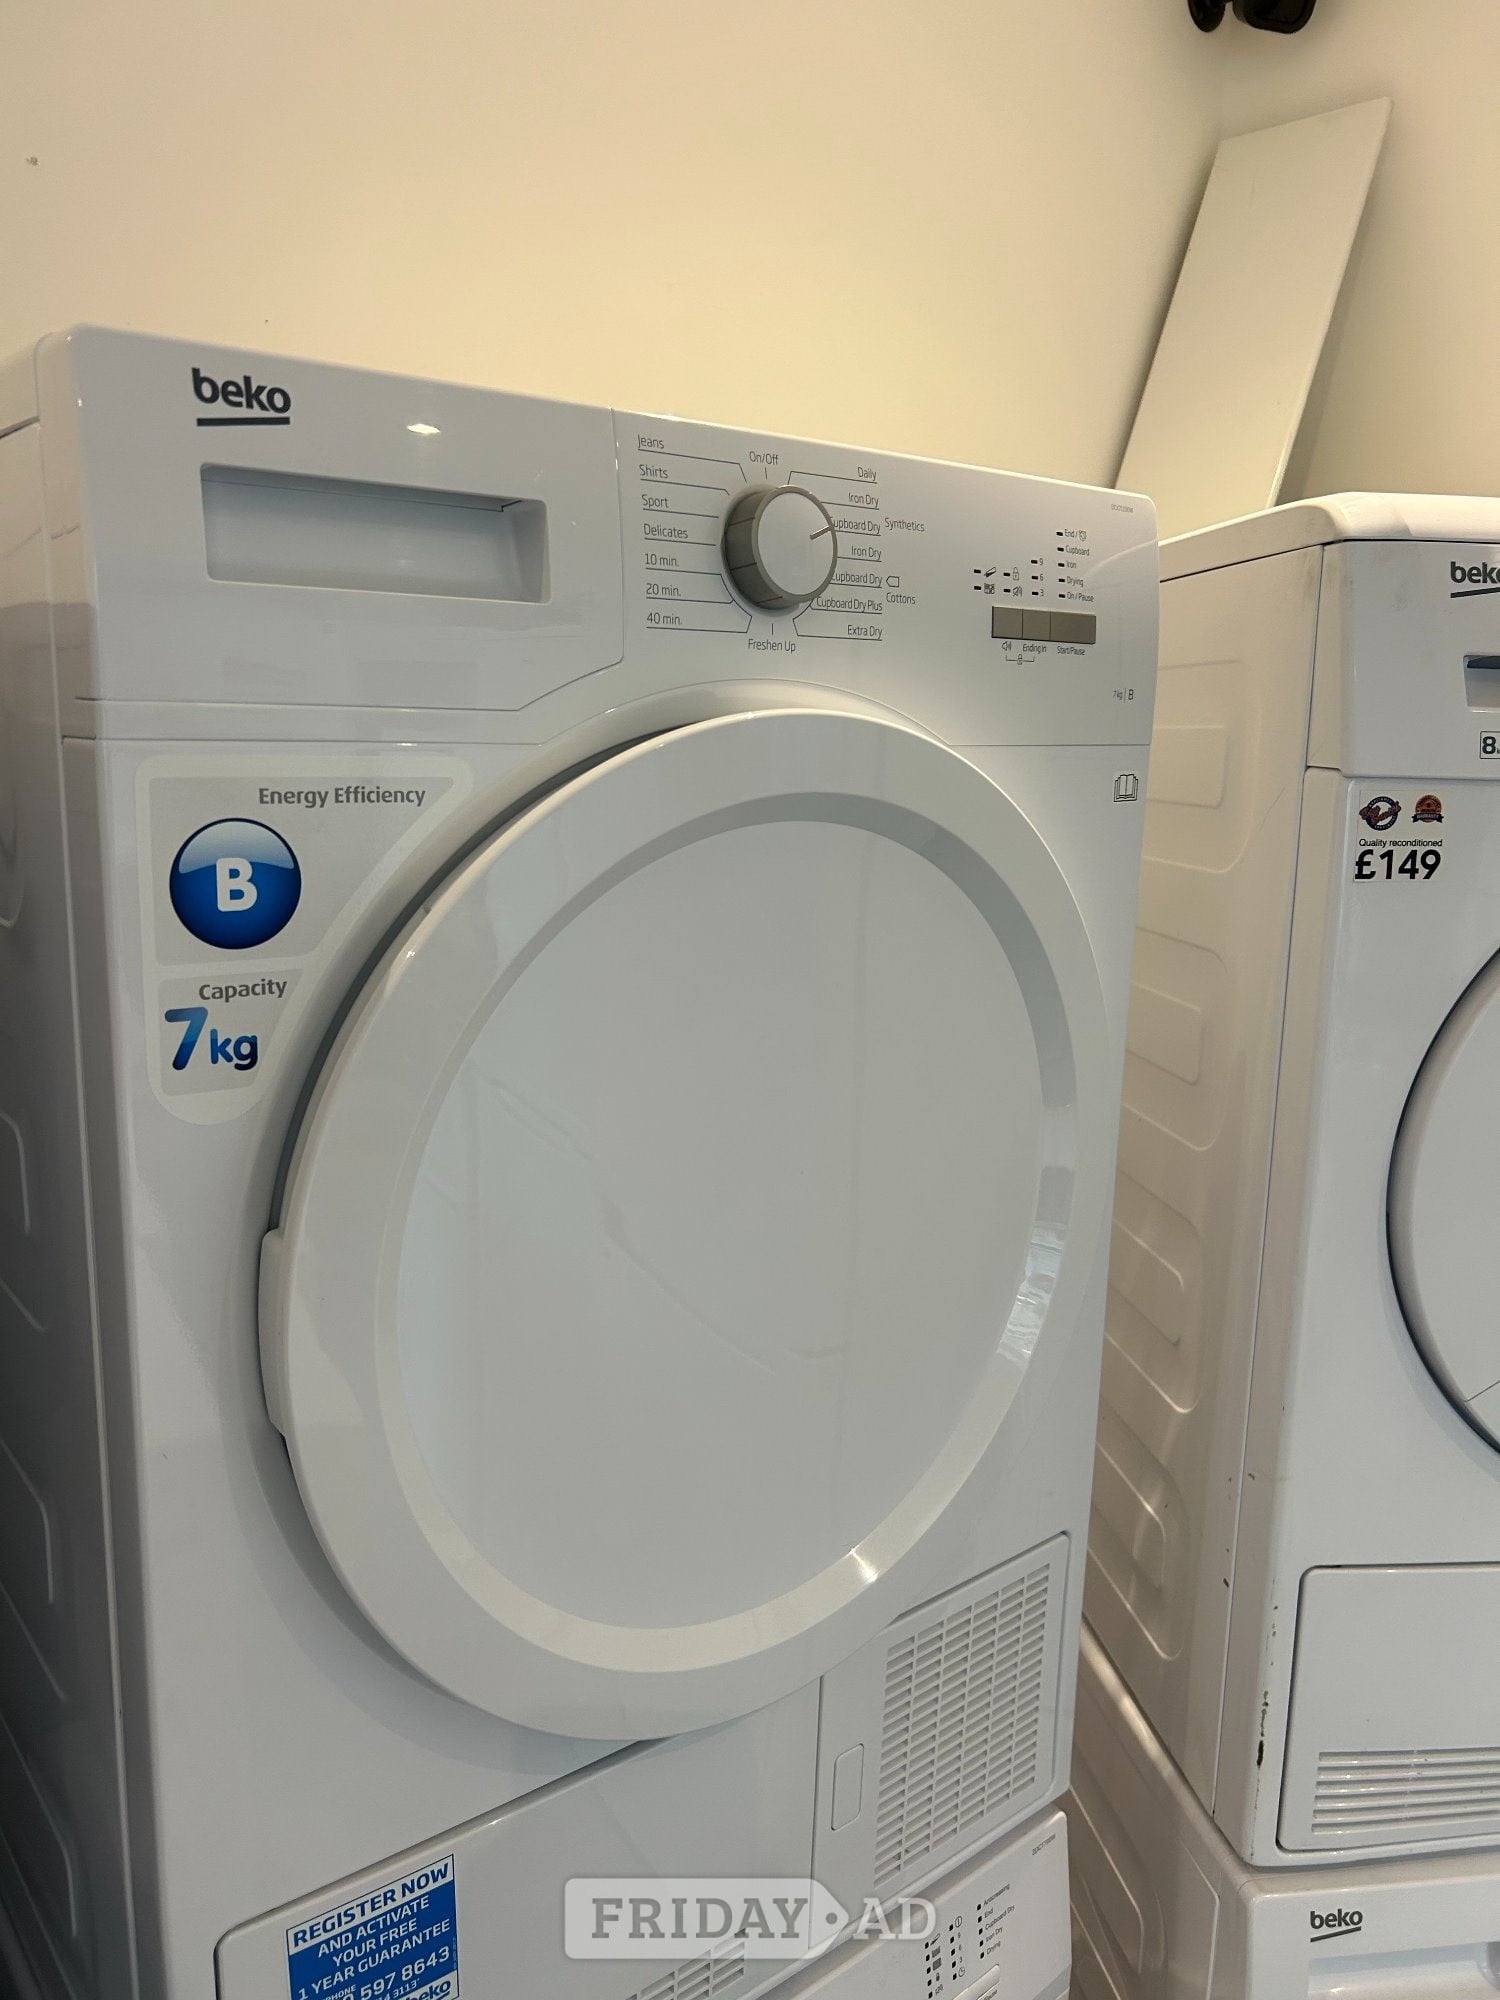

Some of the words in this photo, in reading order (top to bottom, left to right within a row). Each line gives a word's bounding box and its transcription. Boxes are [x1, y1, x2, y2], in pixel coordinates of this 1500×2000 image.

[191, 367, 291, 414] beko
[638, 435, 665, 450] Jeans
[749, 451, 779, 466] On/Off
[639, 464, 669, 480] Shirts
[857, 467, 877, 482] Daily
[641, 495, 668, 510] Sport
[848, 492, 864, 504] Iron
[865, 494, 879, 509] Dry
[643, 523, 688, 539] Delicates
[830, 516, 866, 530] upboard
[867, 520, 881, 535] Dry
[884, 517, 925, 532] Synthetics
[1064, 529, 1075, 538] End
[851, 545, 867, 557] Iron
[868, 546, 882, 561] Dry
[1065, 545, 1090, 556] Cupboard
[645, 553, 657, 567] 10
[659, 554, 680, 568] min.
[1039, 558, 1044, 566] 9
[1066, 560, 1077, 569] Iron
[869, 573, 883, 588] Dry
[1039, 573, 1044, 581] 6
[1066, 575, 1084, 588] Drying
[646, 583, 660, 596] 20
[661, 584, 682, 597] min.
[1039, 588, 1044, 597] 3
[1067, 591, 1075, 600] On
[1078, 593, 1095, 603] Pause
[815, 595, 853, 609] Cupboard
[853, 598, 866, 613] Dry
[867, 600, 883, 611] Plus
[886, 591, 916, 605] Cottons
[646, 612, 661, 625] 40
[662, 614, 682, 626] min.
[847, 625, 867, 637] Extra
[868, 628, 882, 640] Dry
[748, 638, 782, 651] Freshen
[783, 640, 796, 654] Up
[258, 788, 329, 808] Energy
[333, 785, 426, 807] Efficiency
[1359, 839, 1387, 848] Quality
[1389, 839, 1443, 847] reconditioned
[1354, 849, 1441, 879] £149
[216, 857, 257, 912] B
[198, 978, 288, 1003] Capacity
[293, 1889, 397, 1948] REGISTER
[401, 1863, 449, 1898] NOW
[318, 1933, 353, 1958] AND
[356, 1895, 430, 1941] ACTIVATE
[1310, 1908, 1363, 1930] beko
[333, 1939, 376, 1967] YOUR
[380, 1918, 417, 1946] FREE
[298, 1988, 309, 2000] 1
[311, 1968, 355, 1995] YEAR
[358, 1919, 450, 1973] GUARANTEE
[360, 1972, 397, 2000] 597
[401, 1946, 450, 1982] 8643
